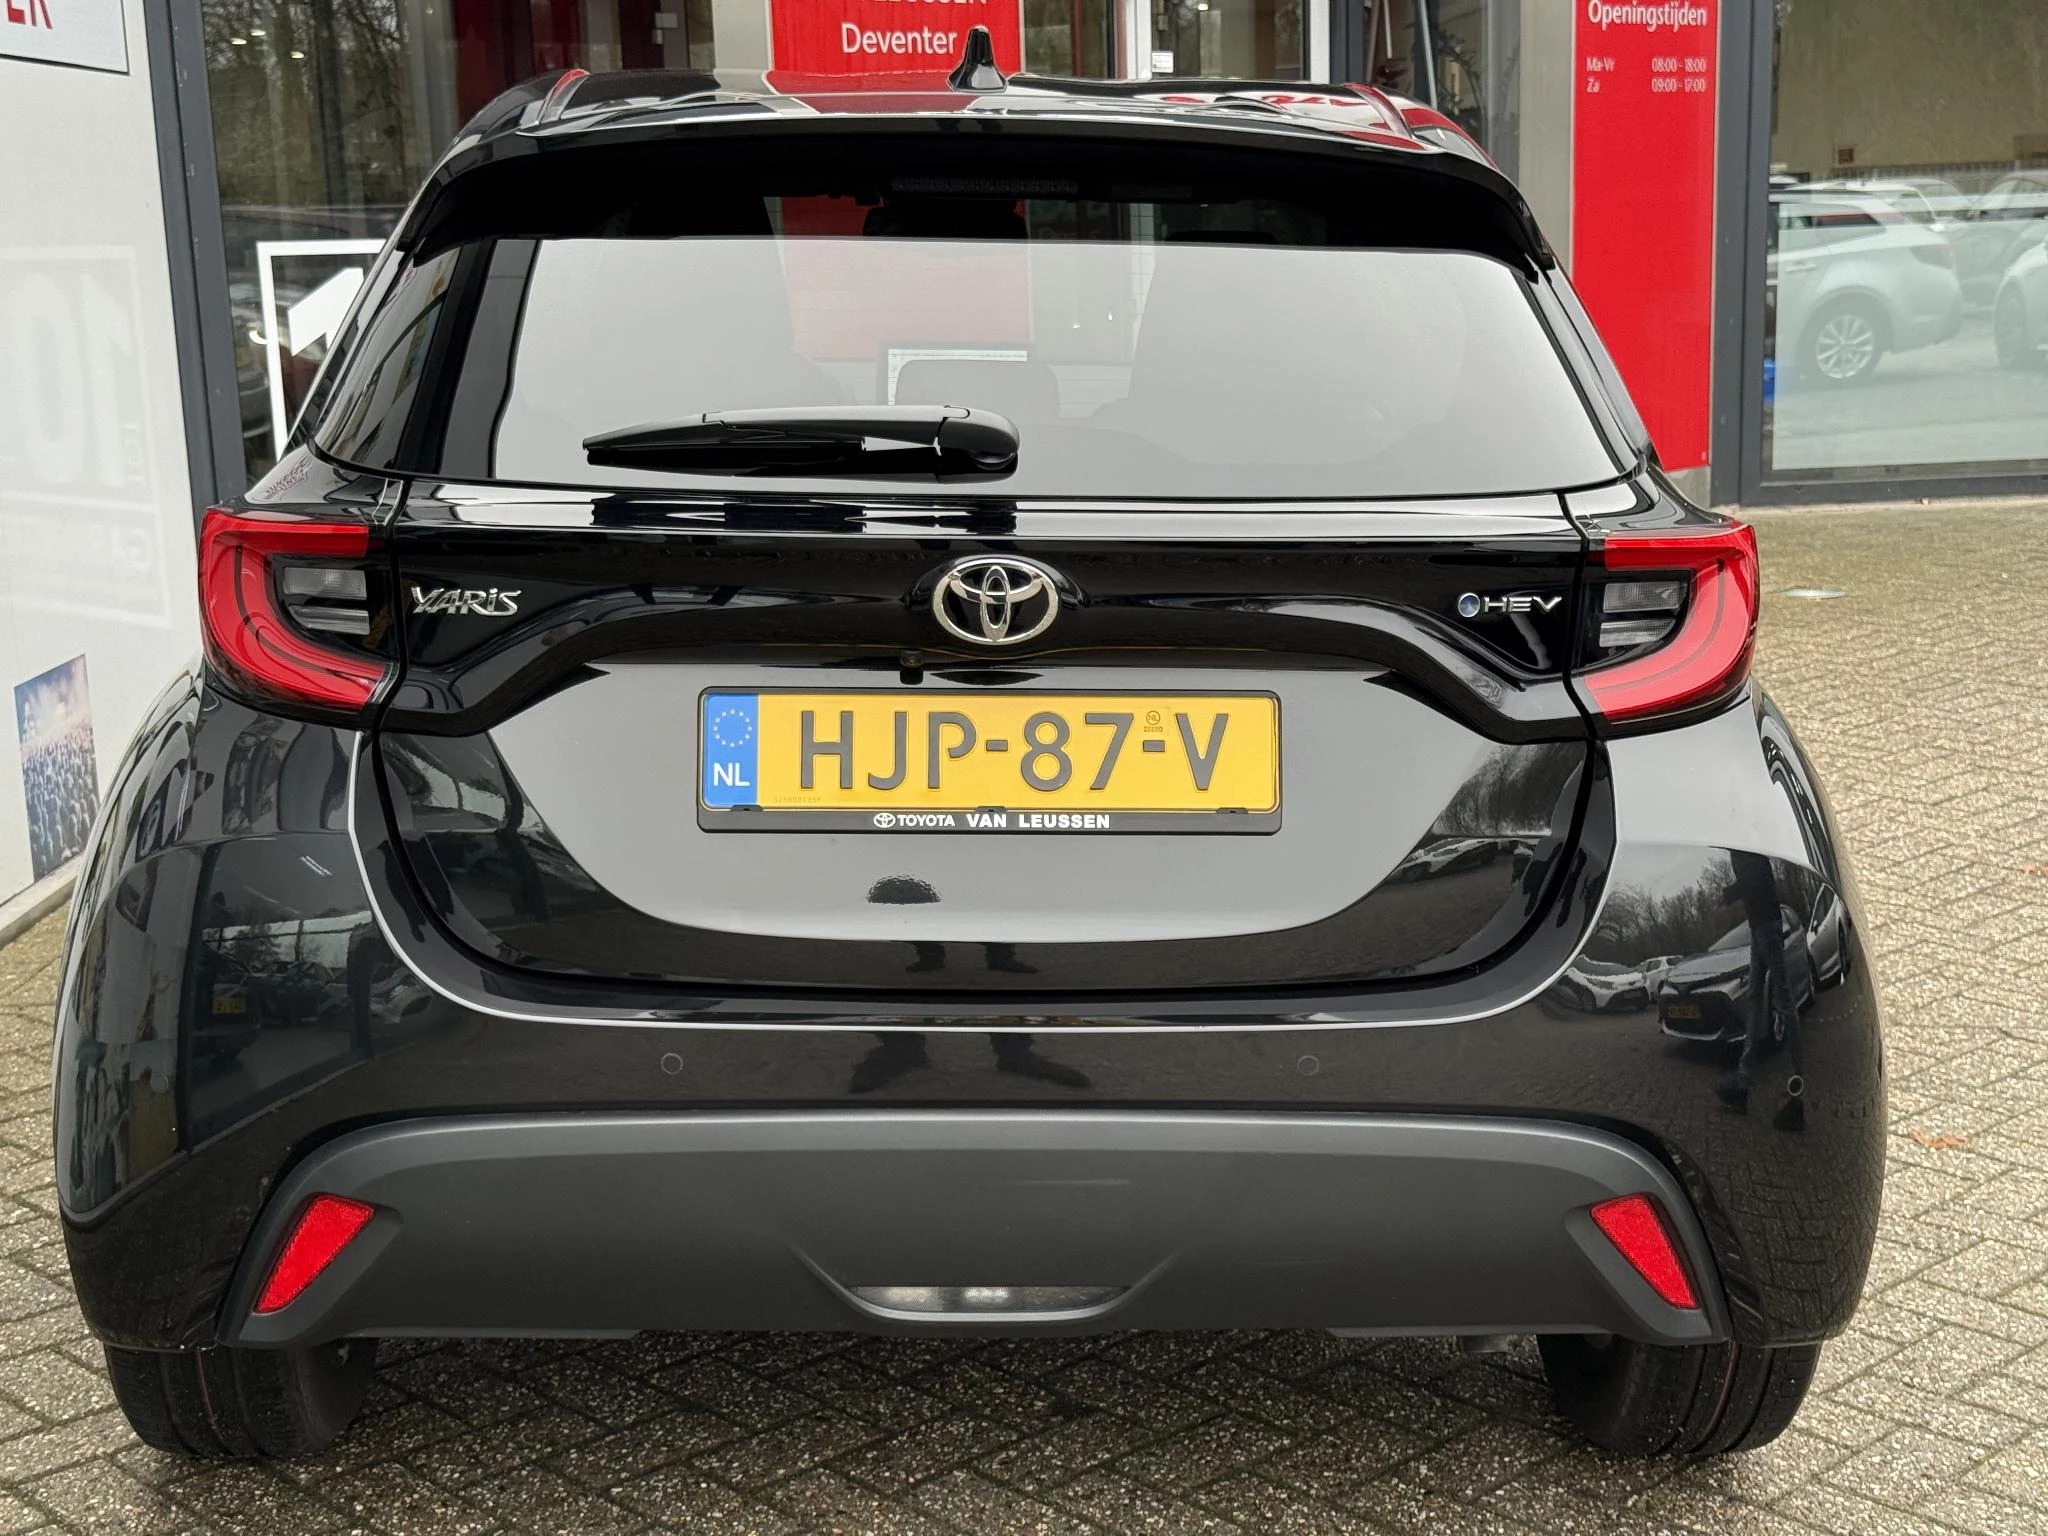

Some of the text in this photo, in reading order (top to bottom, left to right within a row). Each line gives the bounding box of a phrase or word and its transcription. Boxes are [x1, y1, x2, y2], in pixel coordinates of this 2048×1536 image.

[1587, 0, 1707, 32] Openingstijden
[841, 22, 957, 54] Deventer
[1586, 57, 1615, 72] Ma-Vr
[1651, 58, 1677, 73] 08:00
[1684, 58, 1706, 73] 18:00
[1586, 77, 1600, 93] Za
[1651, 78, 1677, 93] 09:00
[1684, 78, 1706, 93] 17:00
[1483, 596, 1562, 613] HEV
[800, 710, 1229, 792] HJP-87-V
[713, 763, 750, 787] NL
[897, 814, 1110, 829] TOYOTA VAN LEUSSEN
